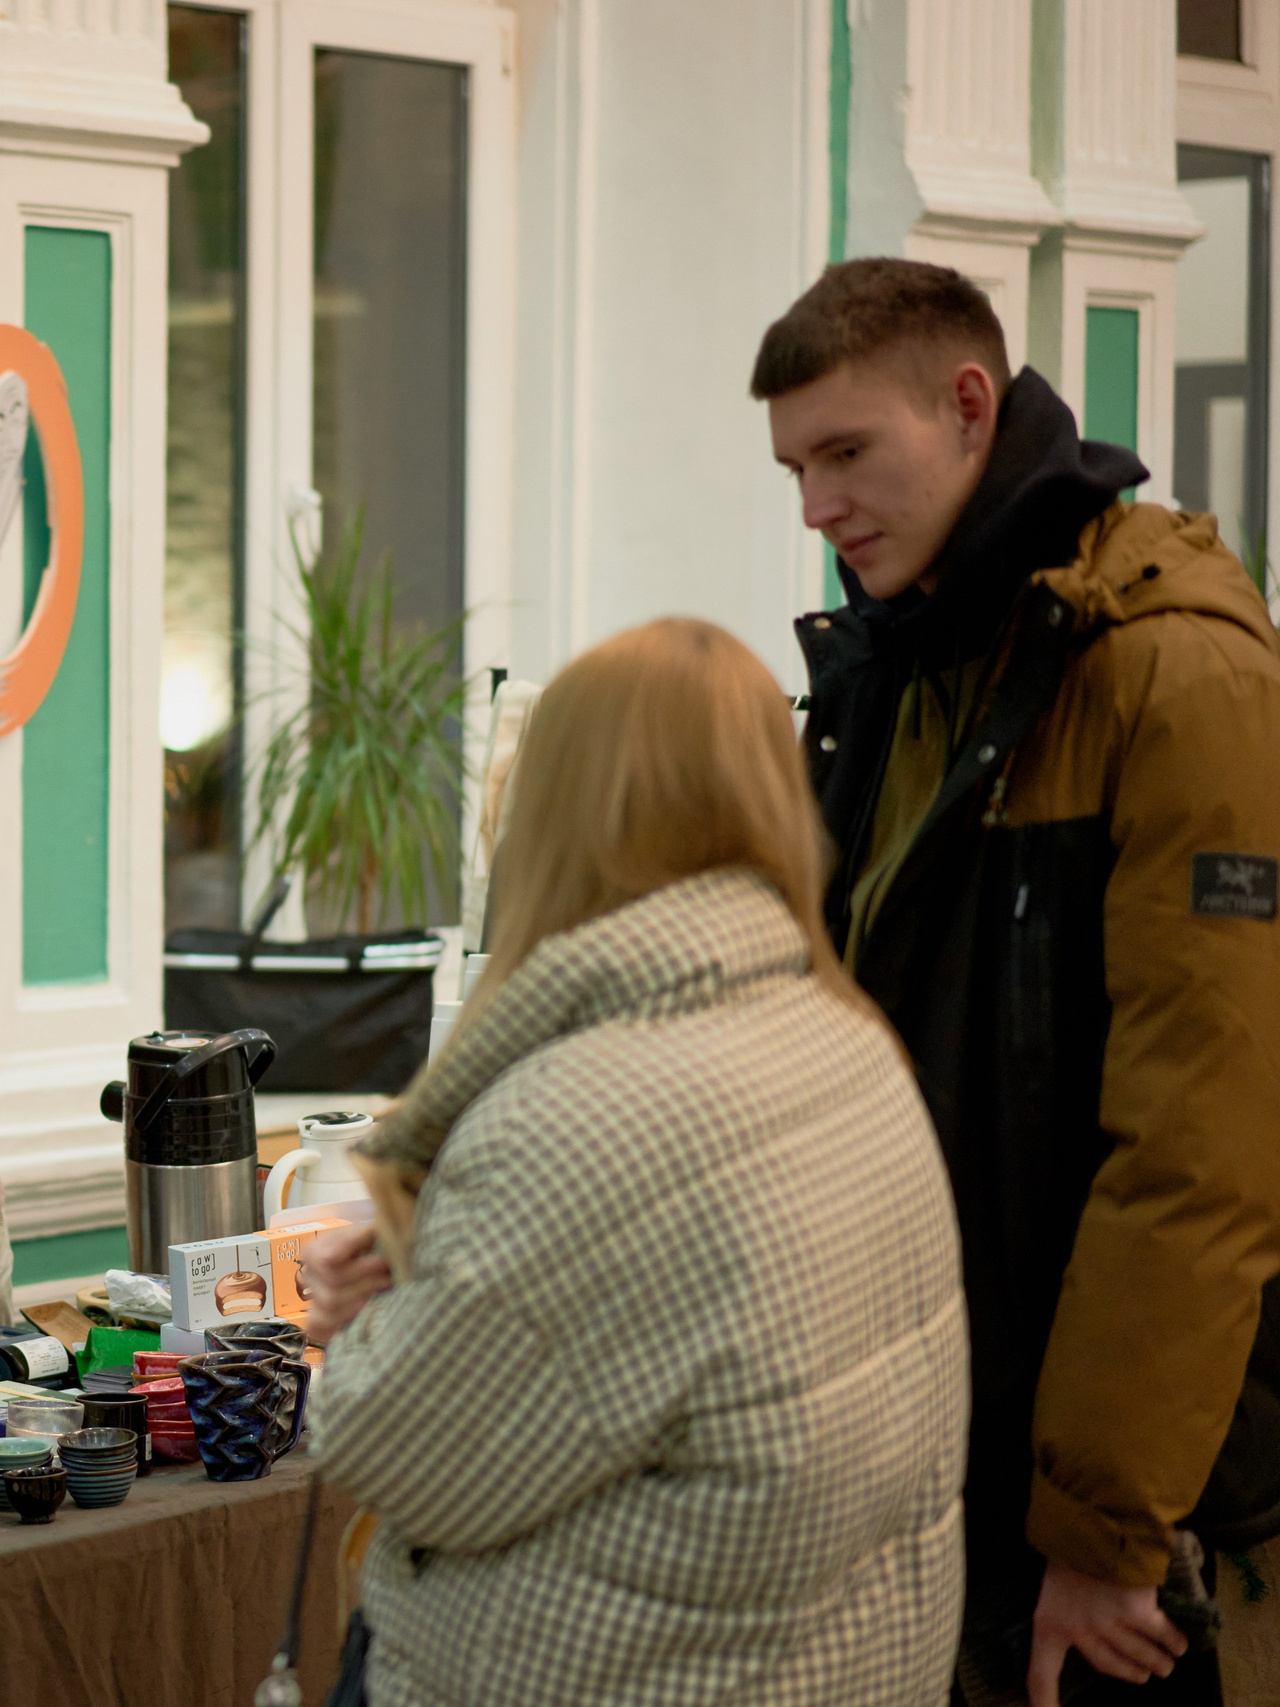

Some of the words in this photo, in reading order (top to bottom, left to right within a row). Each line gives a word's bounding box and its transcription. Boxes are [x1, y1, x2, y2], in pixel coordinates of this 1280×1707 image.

[191, 1254, 211, 1267] raw
[278, 1252, 284, 1261] to
[286, 1249, 295, 1260] go
[192, 1268, 200, 1276] to
[201, 1264, 211, 1276] go
